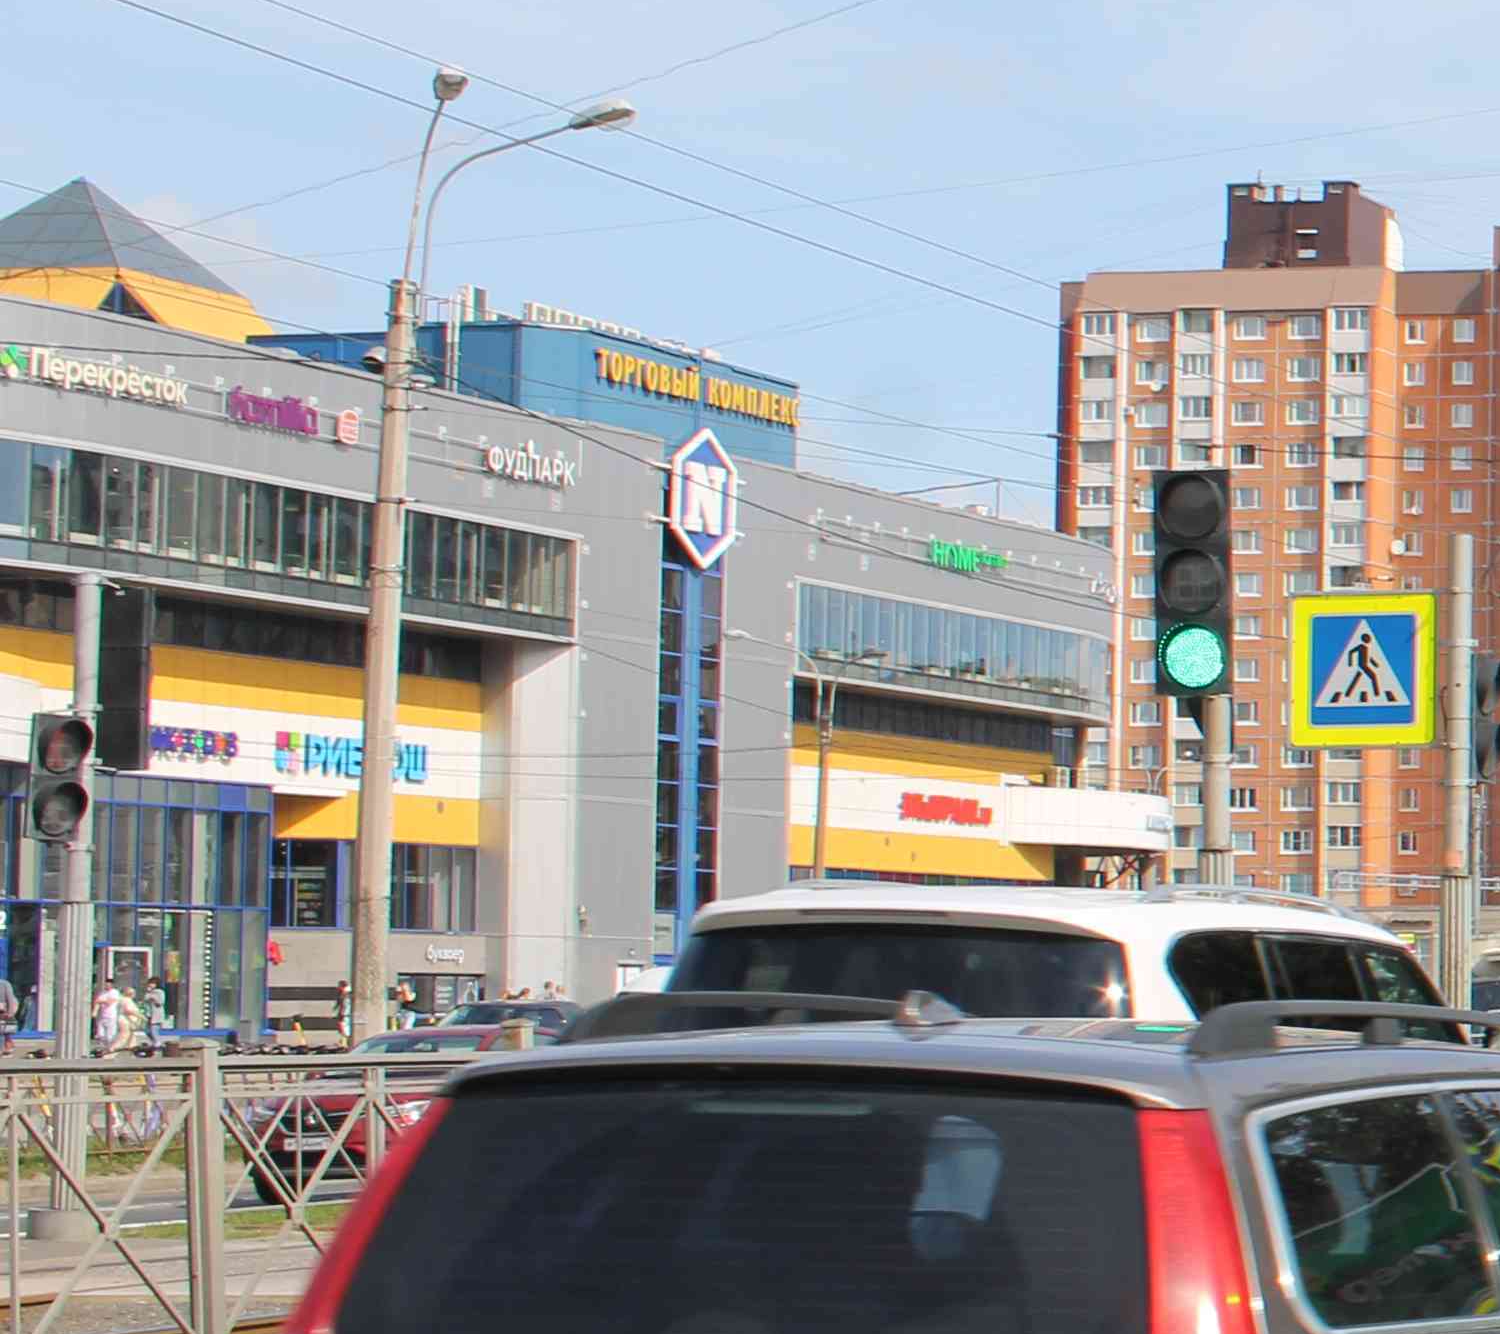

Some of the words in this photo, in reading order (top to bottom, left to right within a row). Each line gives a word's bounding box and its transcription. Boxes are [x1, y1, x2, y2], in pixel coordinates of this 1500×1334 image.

[596, 346, 701, 402] ТОРГОВЫЙ
[707, 378, 801, 428] КОМПЛЕКС
[488, 444, 576, 487] ФУДПАРК
